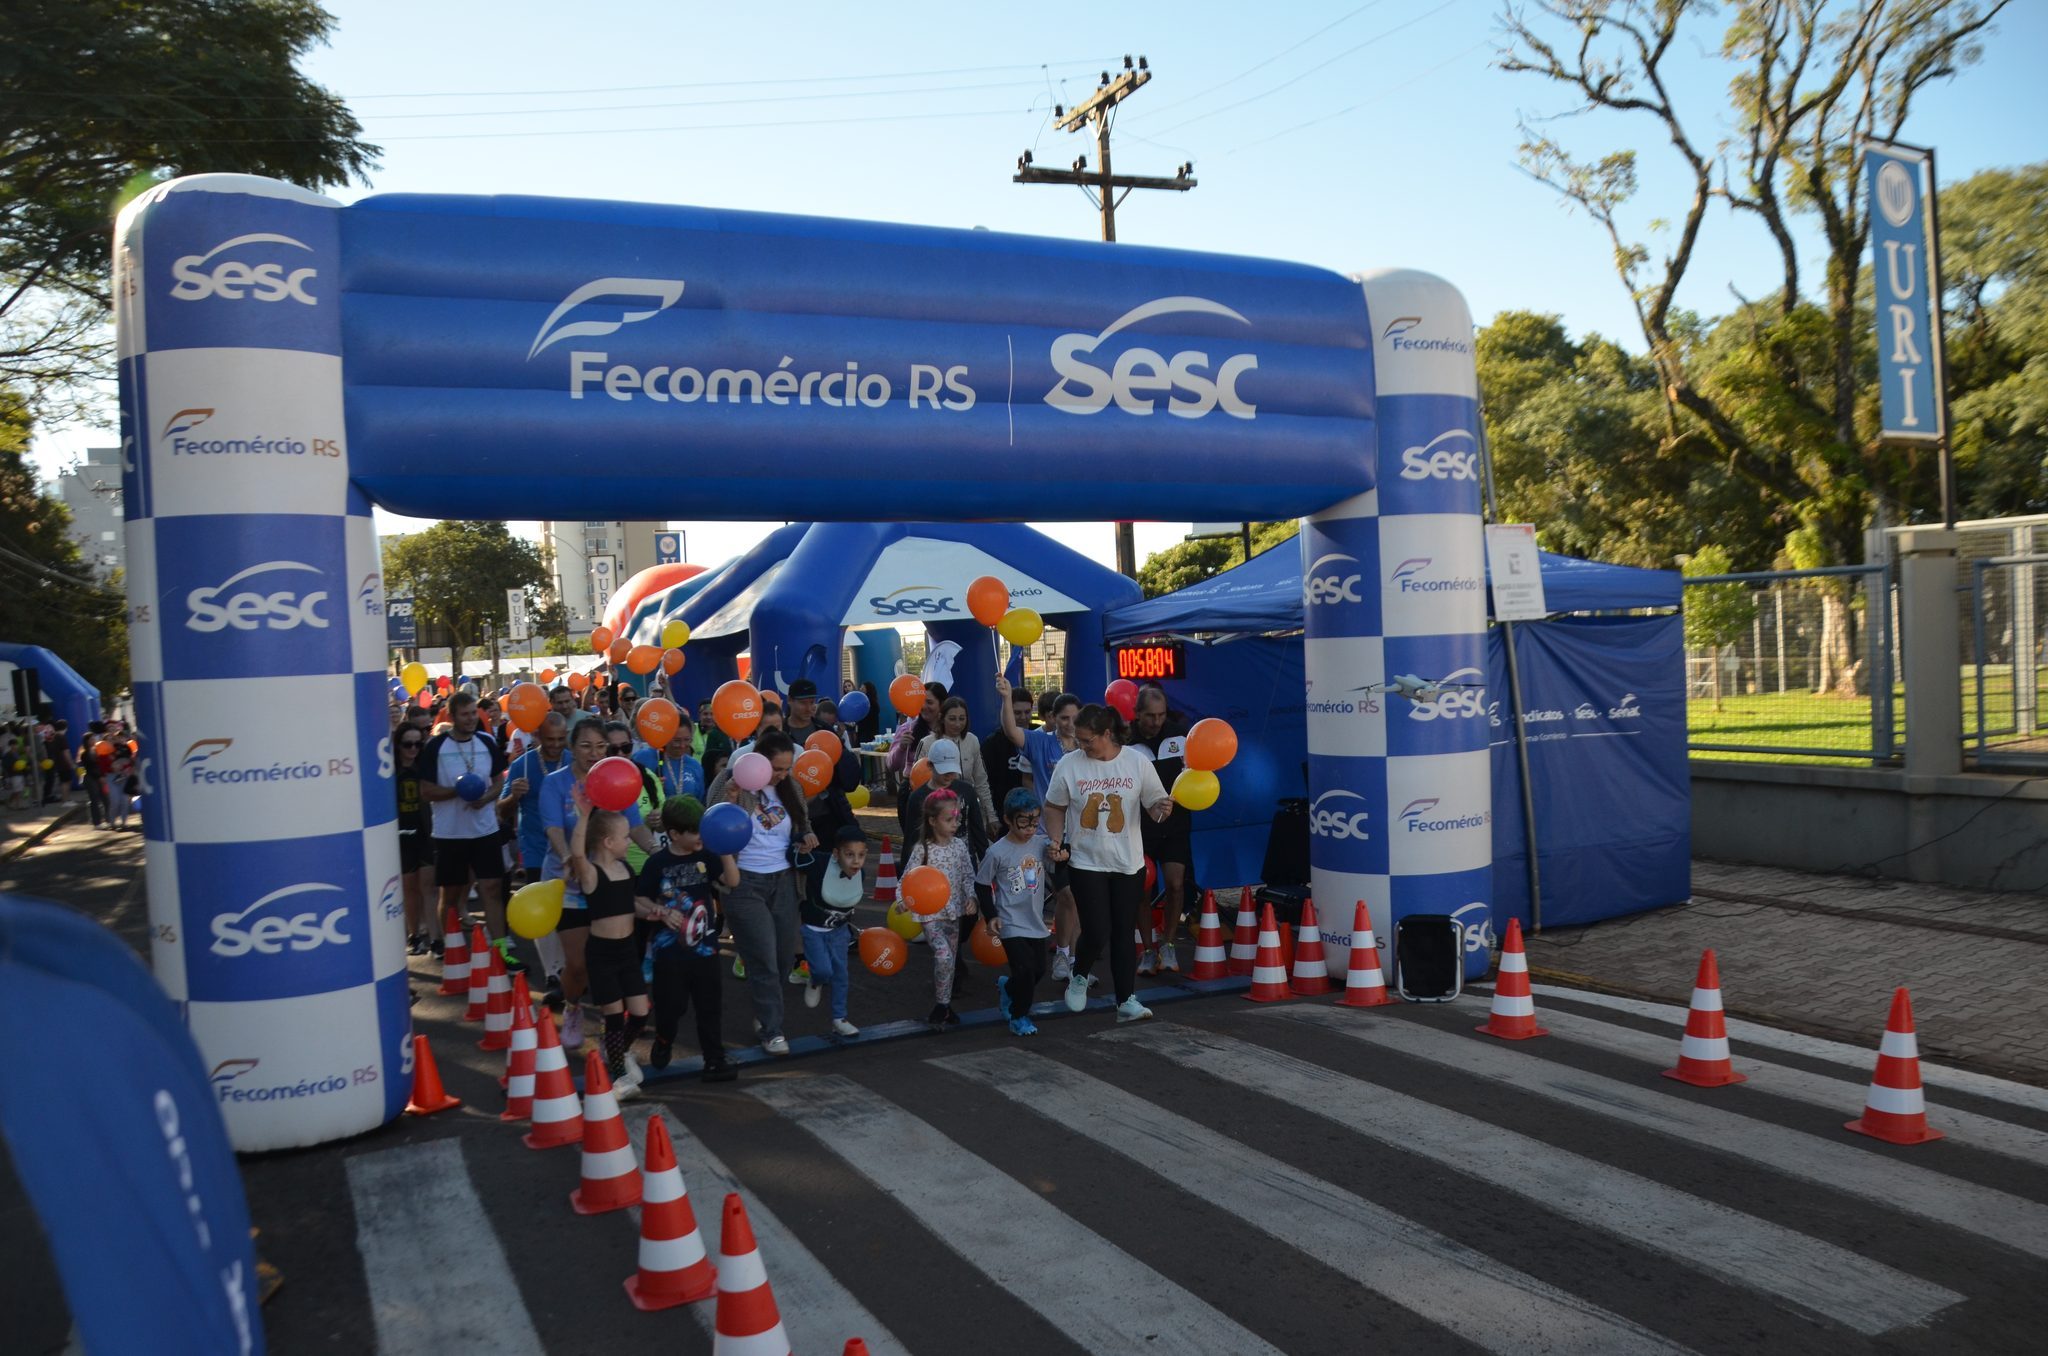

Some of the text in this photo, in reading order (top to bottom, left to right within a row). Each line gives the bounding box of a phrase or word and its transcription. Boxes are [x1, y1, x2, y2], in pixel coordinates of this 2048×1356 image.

[1883, 240, 1922, 427] URI
[569, 351, 977, 412] Fecomércio RS
[173, 434, 340, 458] Fecomércio RS
[1358, 699, 1380, 714] RS
[192, 762, 322, 785] Fecomércio
[328, 758, 354, 777] RS
[1080, 777, 1134, 796] CAPYBARAS
[1409, 812, 1484, 832] Fecomércio
[219, 1065, 378, 1103] Fecomércio RS
